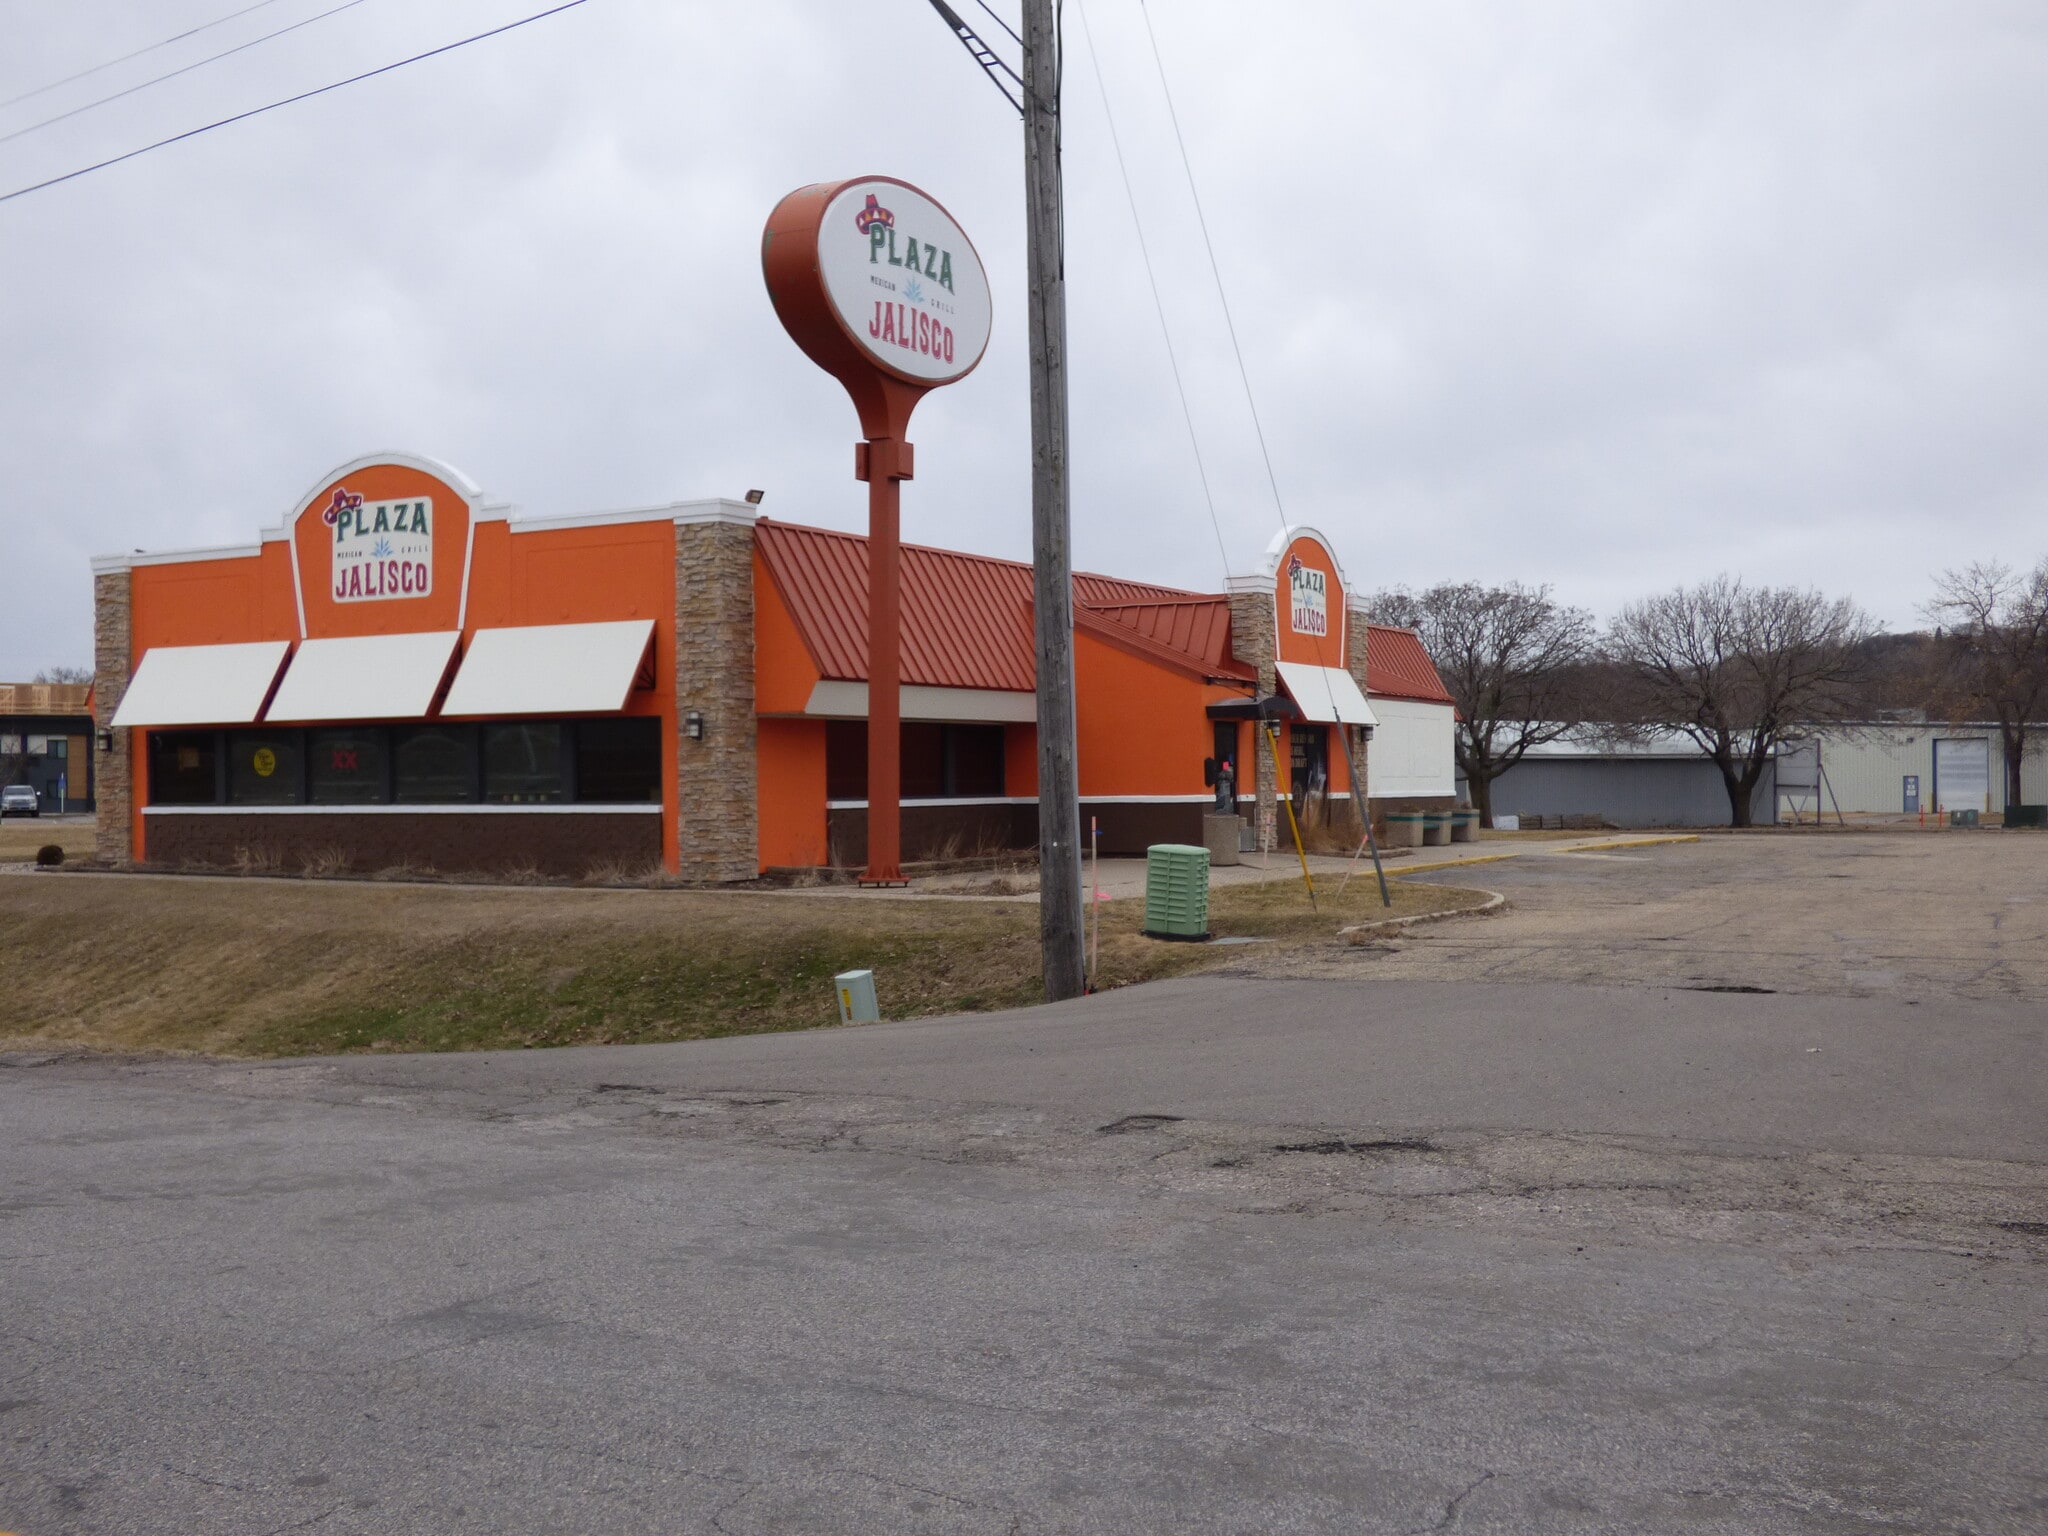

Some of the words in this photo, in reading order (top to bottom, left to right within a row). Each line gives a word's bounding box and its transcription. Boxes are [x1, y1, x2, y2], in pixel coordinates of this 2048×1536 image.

[869, 223, 955, 296] PLAZA
[870, 275, 896, 291] MEXICAN
[869, 301, 953, 364] JALISCO
[336, 502, 429, 543] PLAZA
[335, 560, 428, 598] JALISCO
[1292, 568, 1325, 597] PLAZA
[1293, 607, 1325, 634] JALISCO
